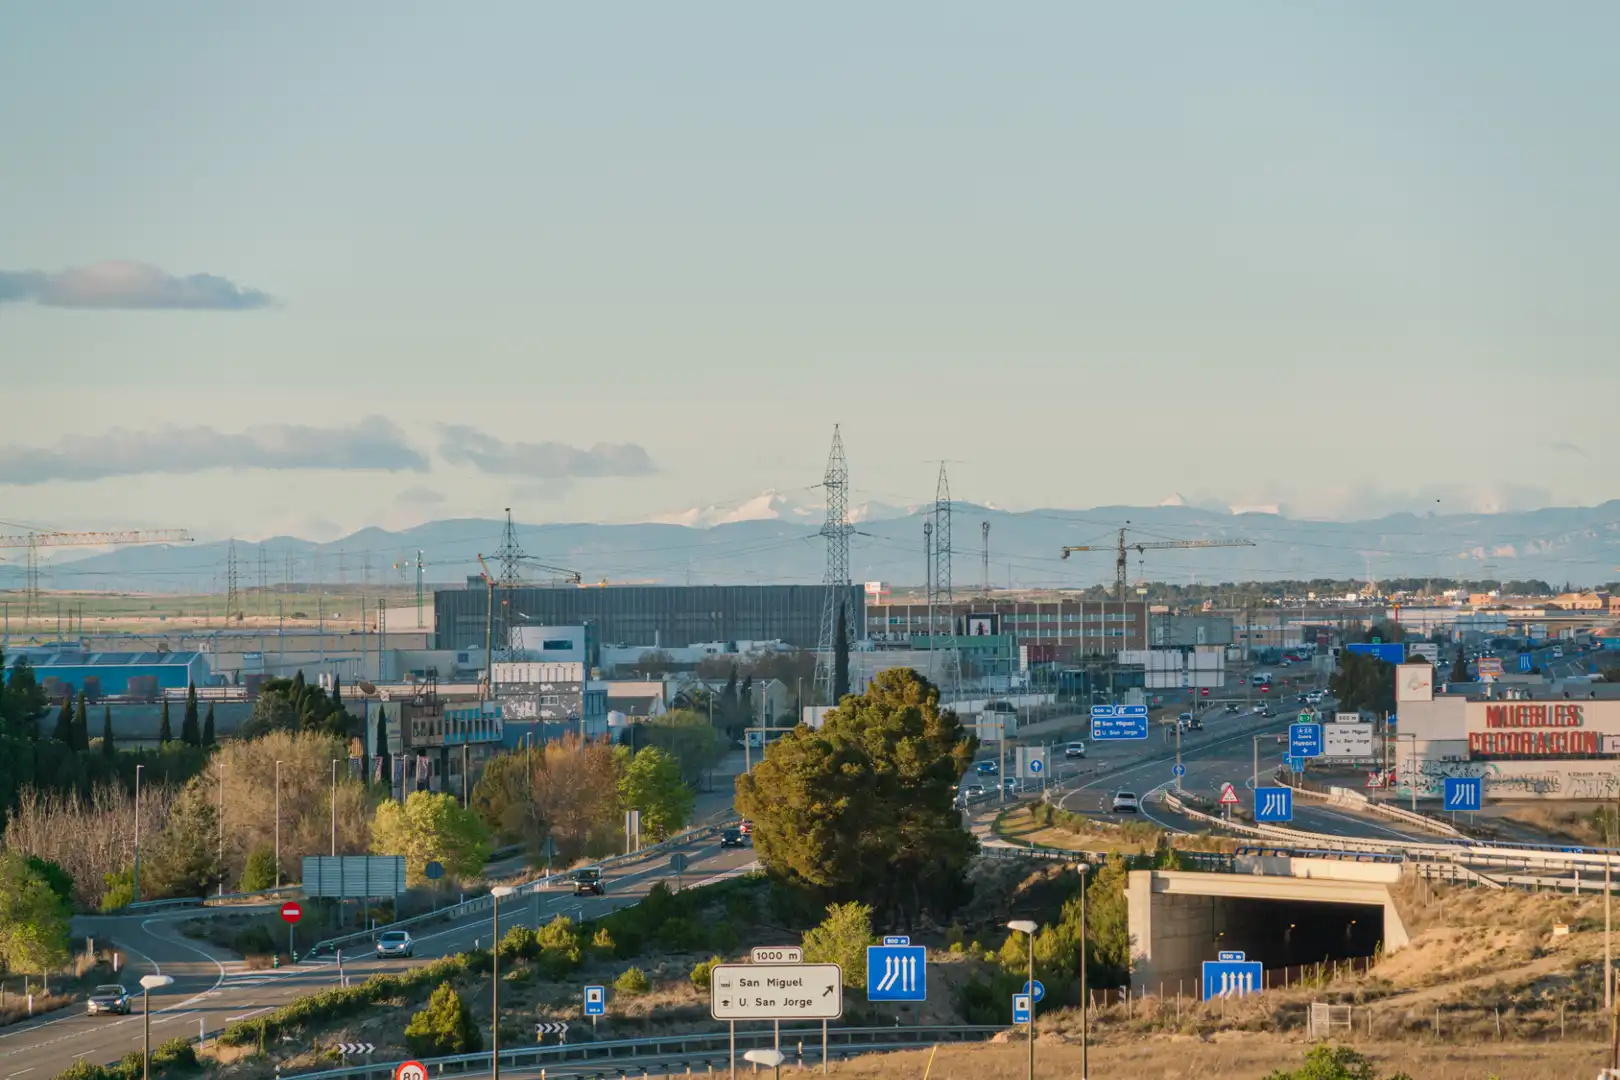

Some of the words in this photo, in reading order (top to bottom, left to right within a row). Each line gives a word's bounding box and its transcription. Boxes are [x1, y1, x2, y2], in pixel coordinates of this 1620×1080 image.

[1486, 704, 1583, 728] MUEBLES
[756, 952, 782, 960] 1000
[740, 978, 760, 987] San
[767, 978, 803, 988] Miguel
[739, 998, 749, 1006] U.
[755, 998, 776, 1006] San
[783, 998, 812, 1008] Jorge
[404, 1072, 420, 1080] 80
